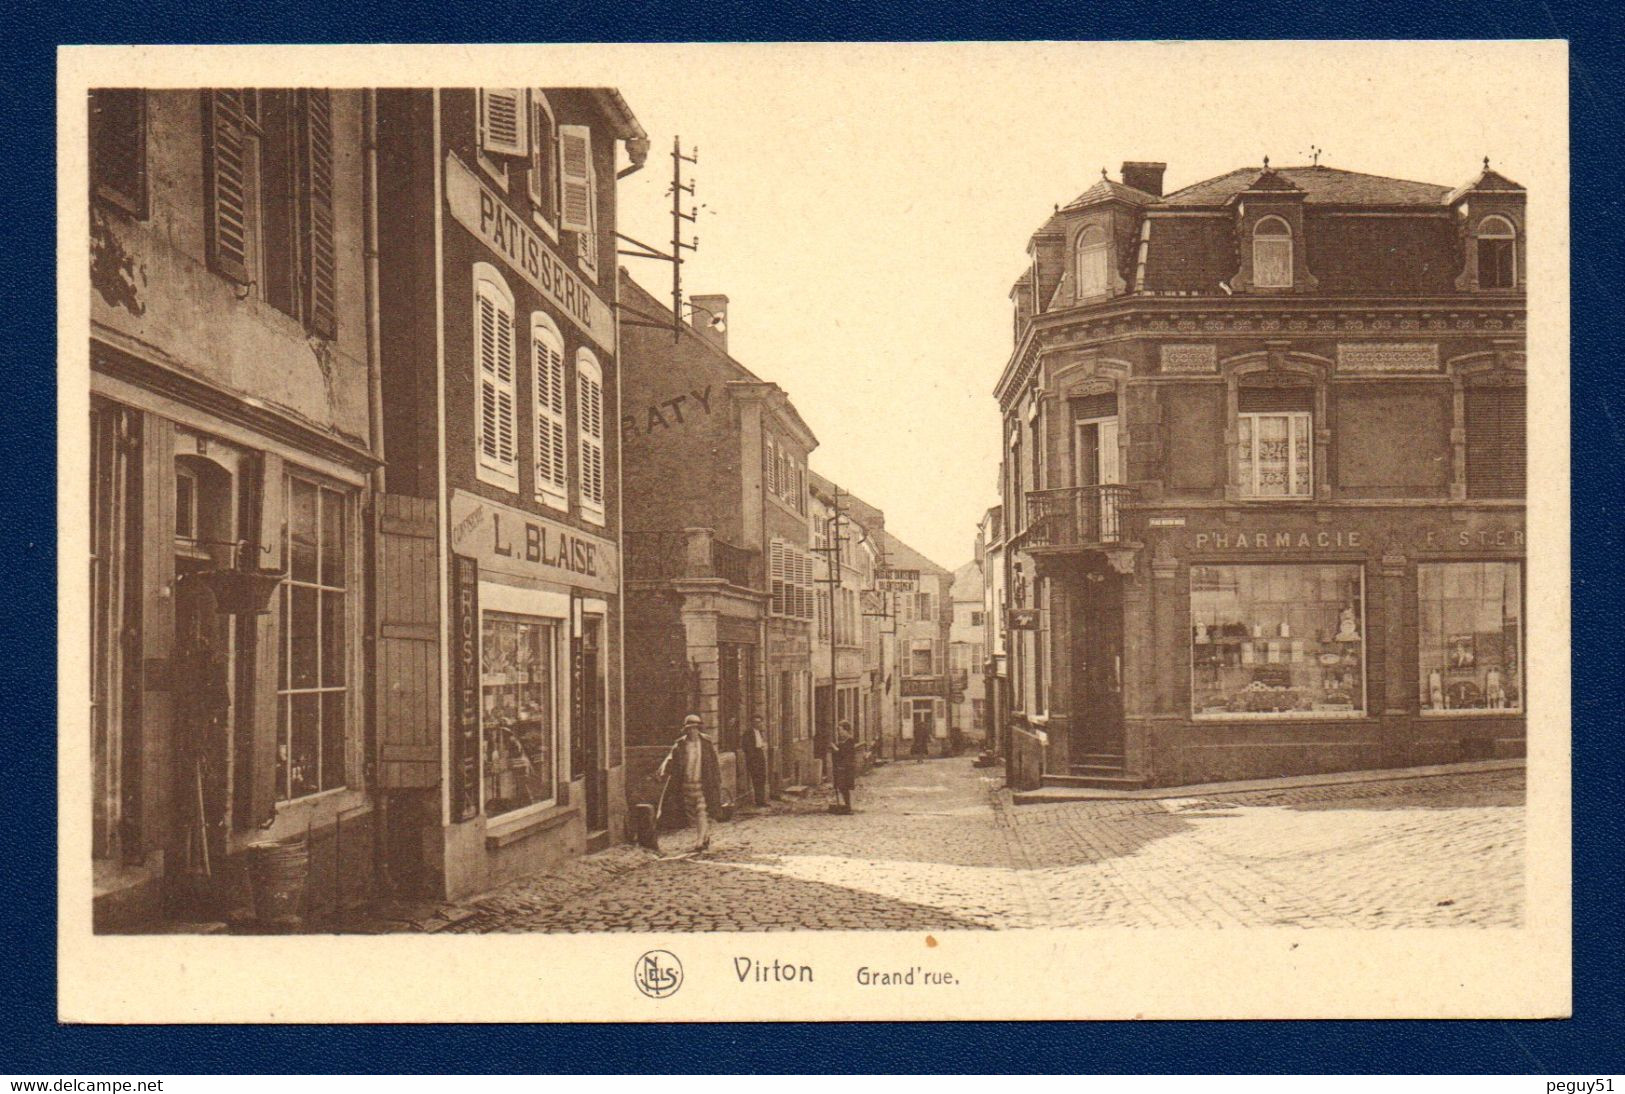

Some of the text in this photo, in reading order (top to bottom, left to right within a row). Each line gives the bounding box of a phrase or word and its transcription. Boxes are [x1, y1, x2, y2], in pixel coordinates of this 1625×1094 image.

[480, 189, 592, 329] PATISSERIE
[493, 512, 522, 560] L.
[525, 521, 598, 578] BLAISE
